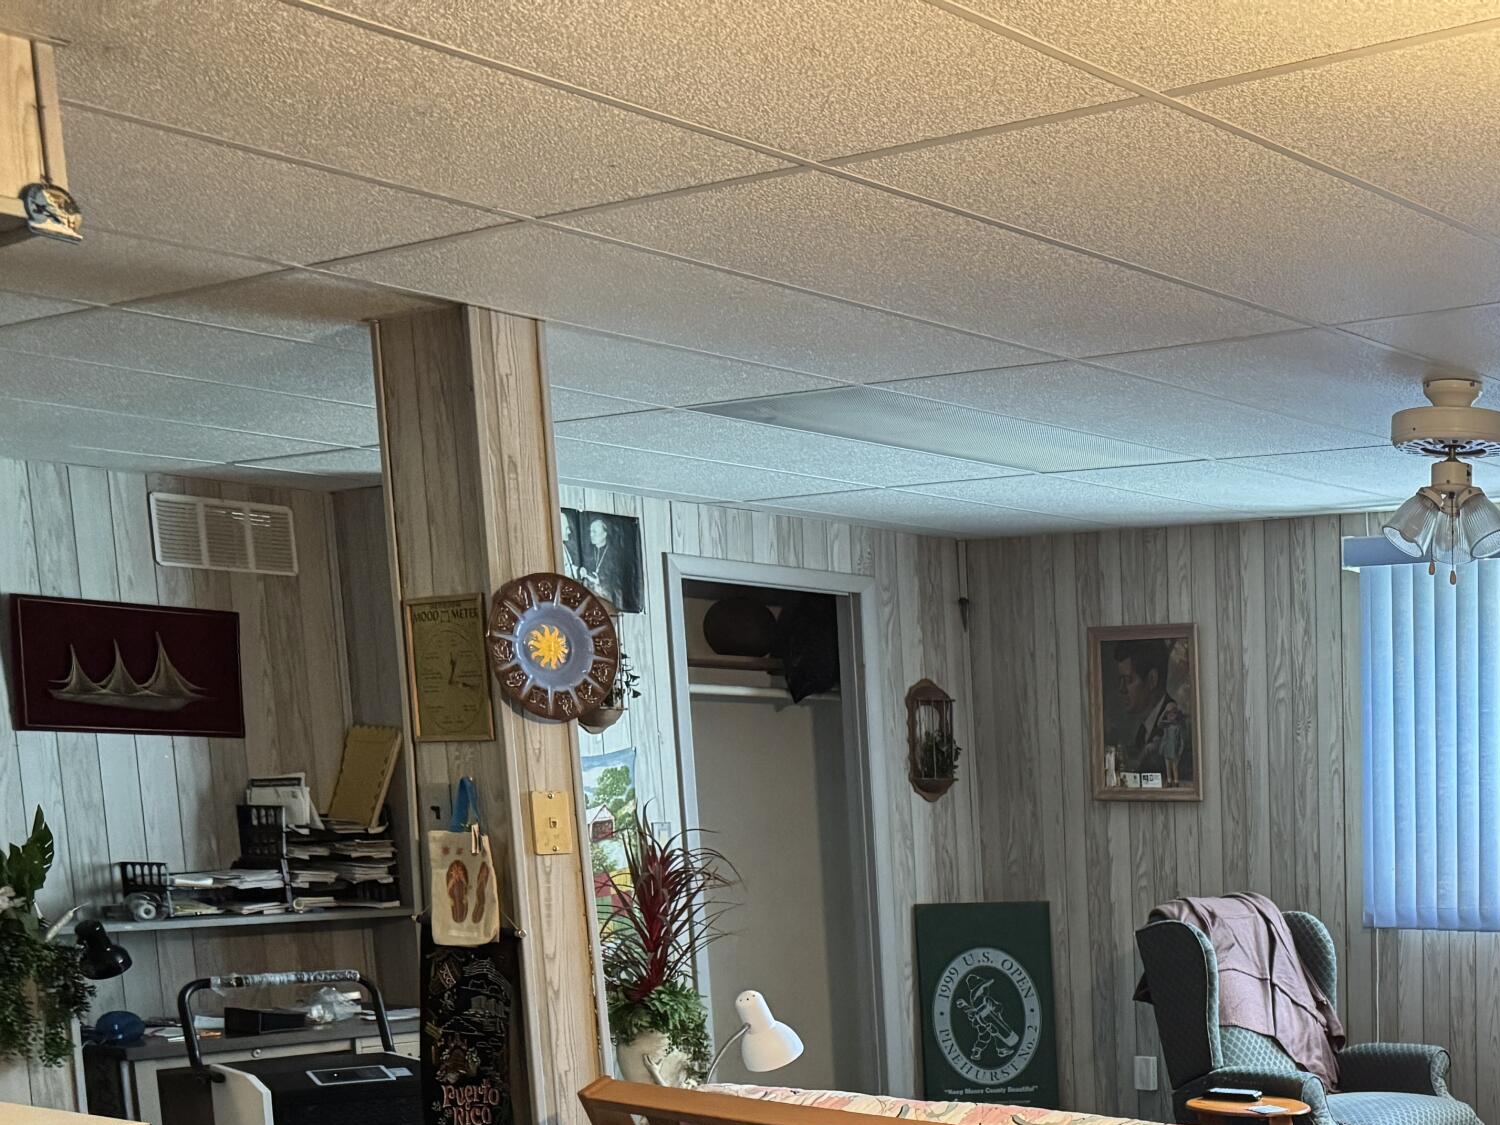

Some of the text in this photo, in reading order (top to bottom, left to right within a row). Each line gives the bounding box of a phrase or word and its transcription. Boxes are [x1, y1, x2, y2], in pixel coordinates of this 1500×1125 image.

[414, 607, 479, 623] MOOD METER
[938, 951, 1035, 1000] 1999 U.S. OPEN
[939, 1028, 1020, 1082] PINEHURST
[1027, 1024, 1038, 1033] 2
